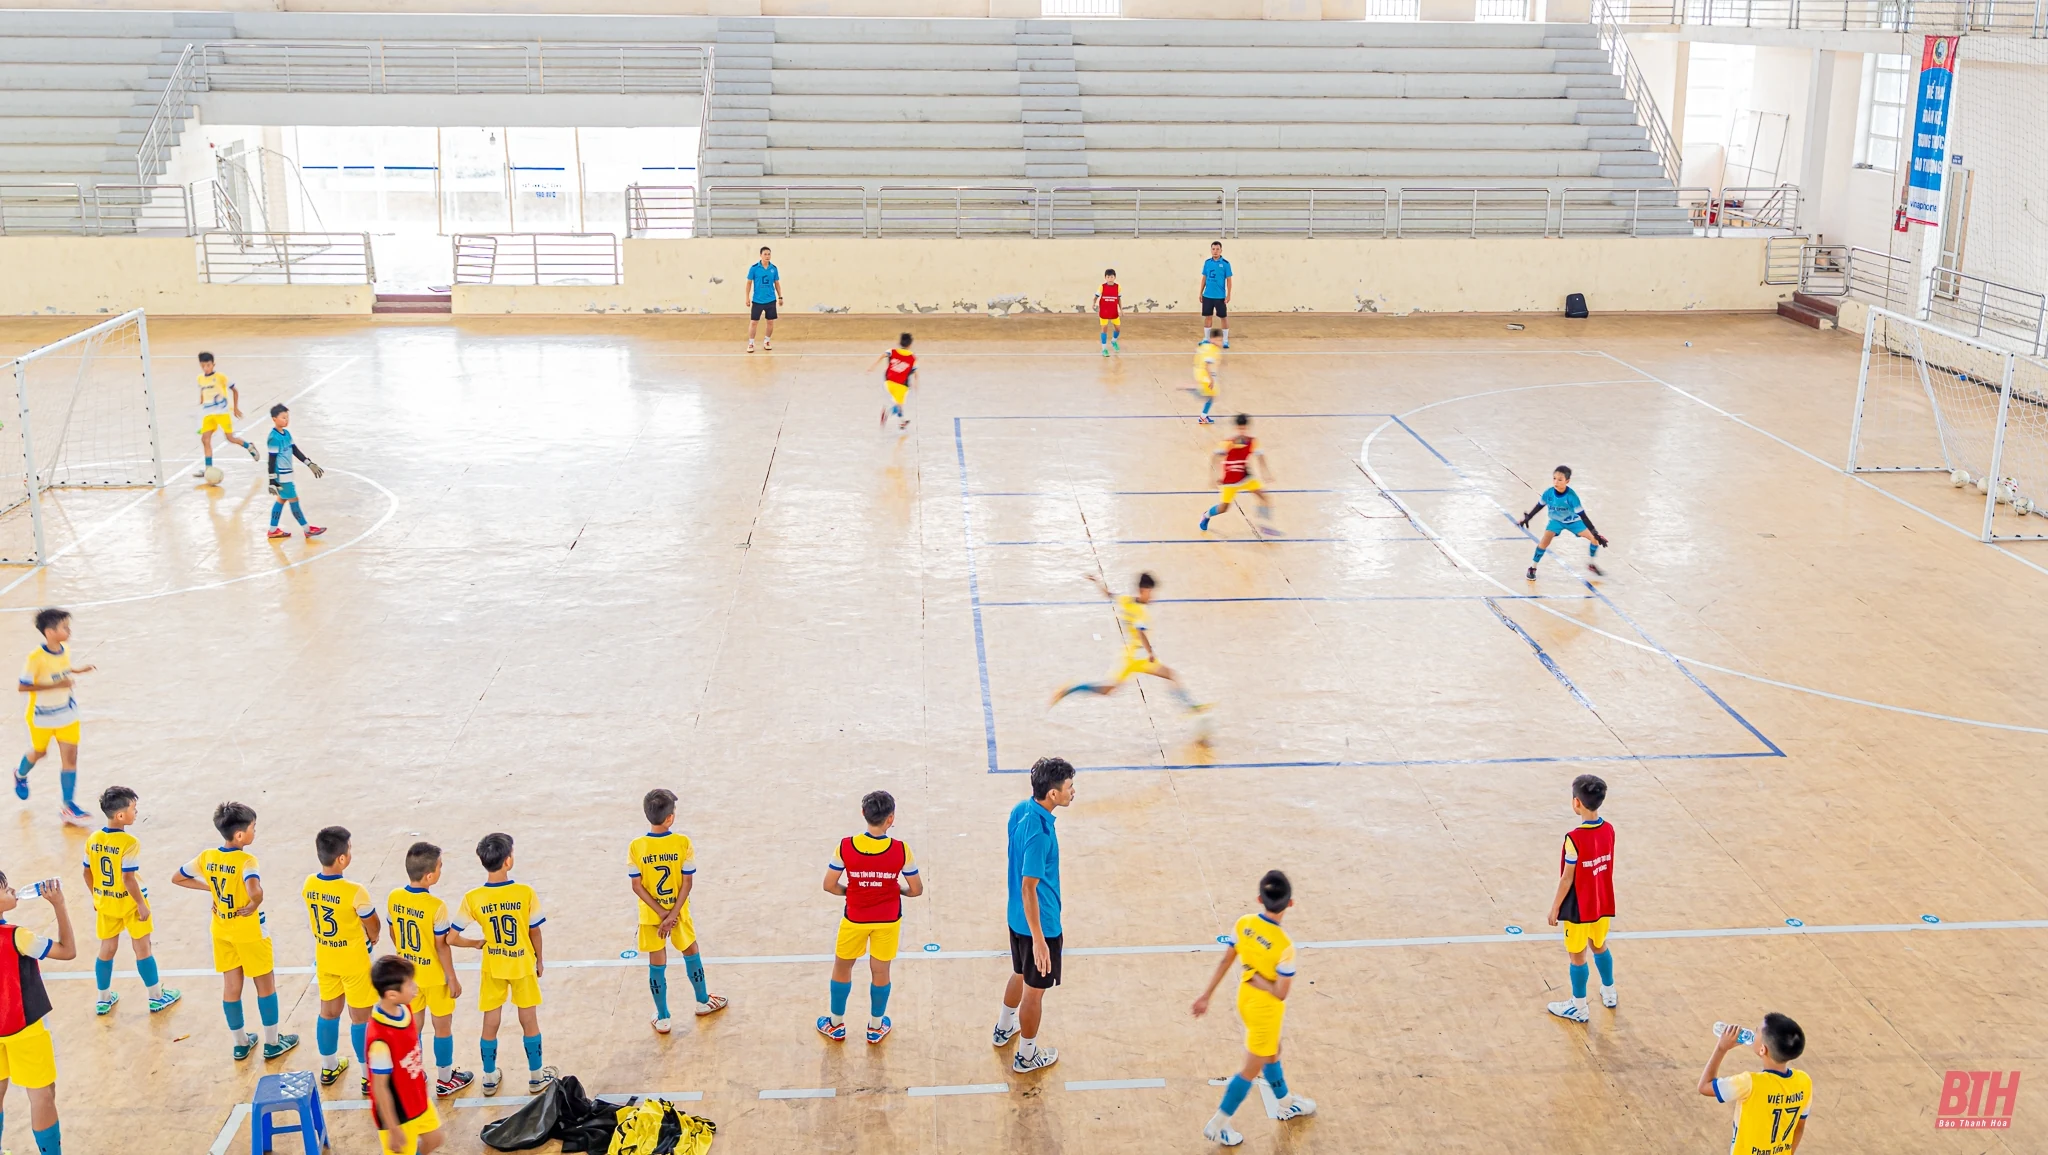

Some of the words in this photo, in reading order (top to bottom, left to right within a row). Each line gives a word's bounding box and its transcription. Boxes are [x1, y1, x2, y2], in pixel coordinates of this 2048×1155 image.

[100, 856, 114, 886] 9
[654, 866, 674, 896] 2
[311, 904, 338, 937] 13
[481, 903, 497, 914] VIỆT
[500, 901, 521, 910] HÙNG
[397, 917, 421, 952] 10
[489, 914, 517, 946] 19
[1768, 1093, 1784, 1106] VIỆT
[1771, 1106, 1800, 1144] 17
